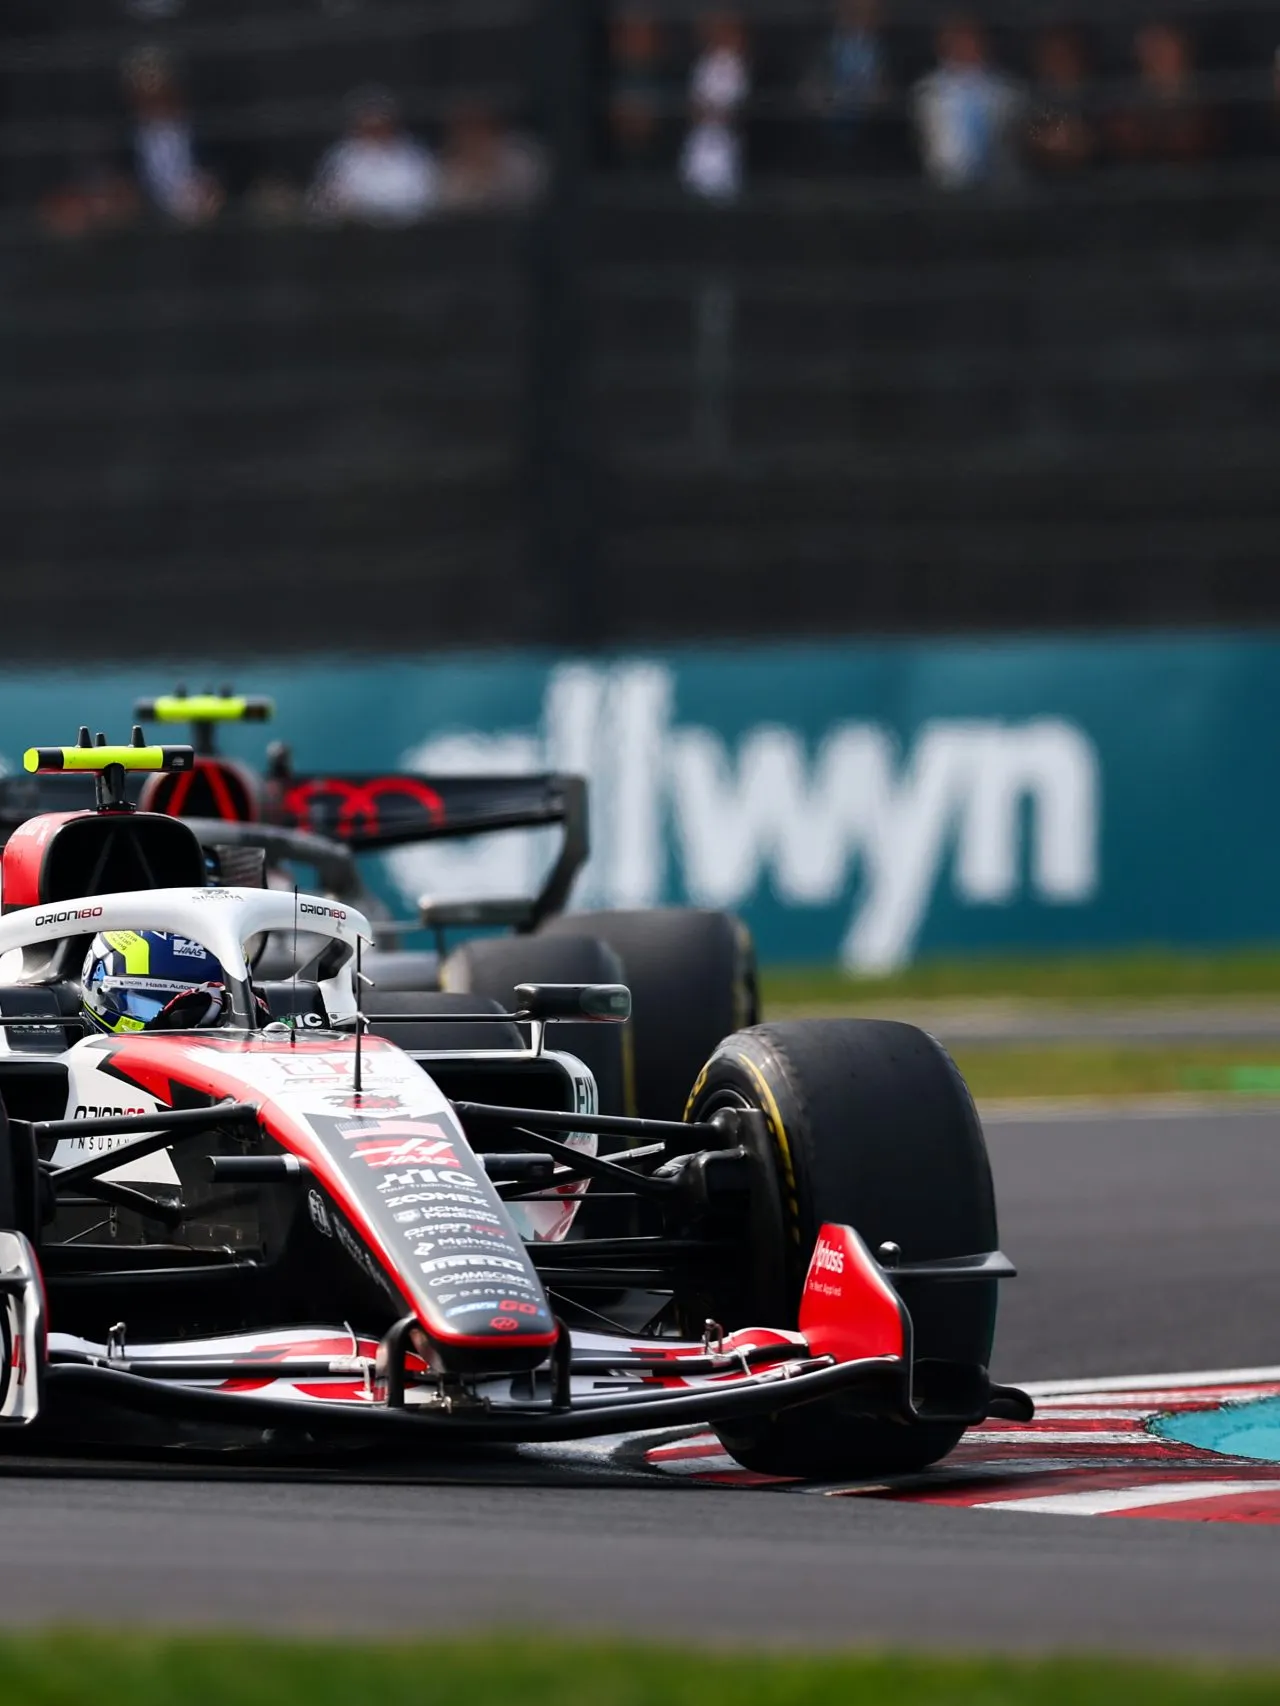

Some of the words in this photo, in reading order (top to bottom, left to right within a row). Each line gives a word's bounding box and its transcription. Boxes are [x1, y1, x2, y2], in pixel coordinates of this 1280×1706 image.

[35, 907, 103, 926] ORION180
[300, 903, 347, 920] ORION180
[177, 946, 203, 956] HAAS
[145, 981, 168, 989] Haas
[385, 1192, 491, 1208] ZOOMEX
